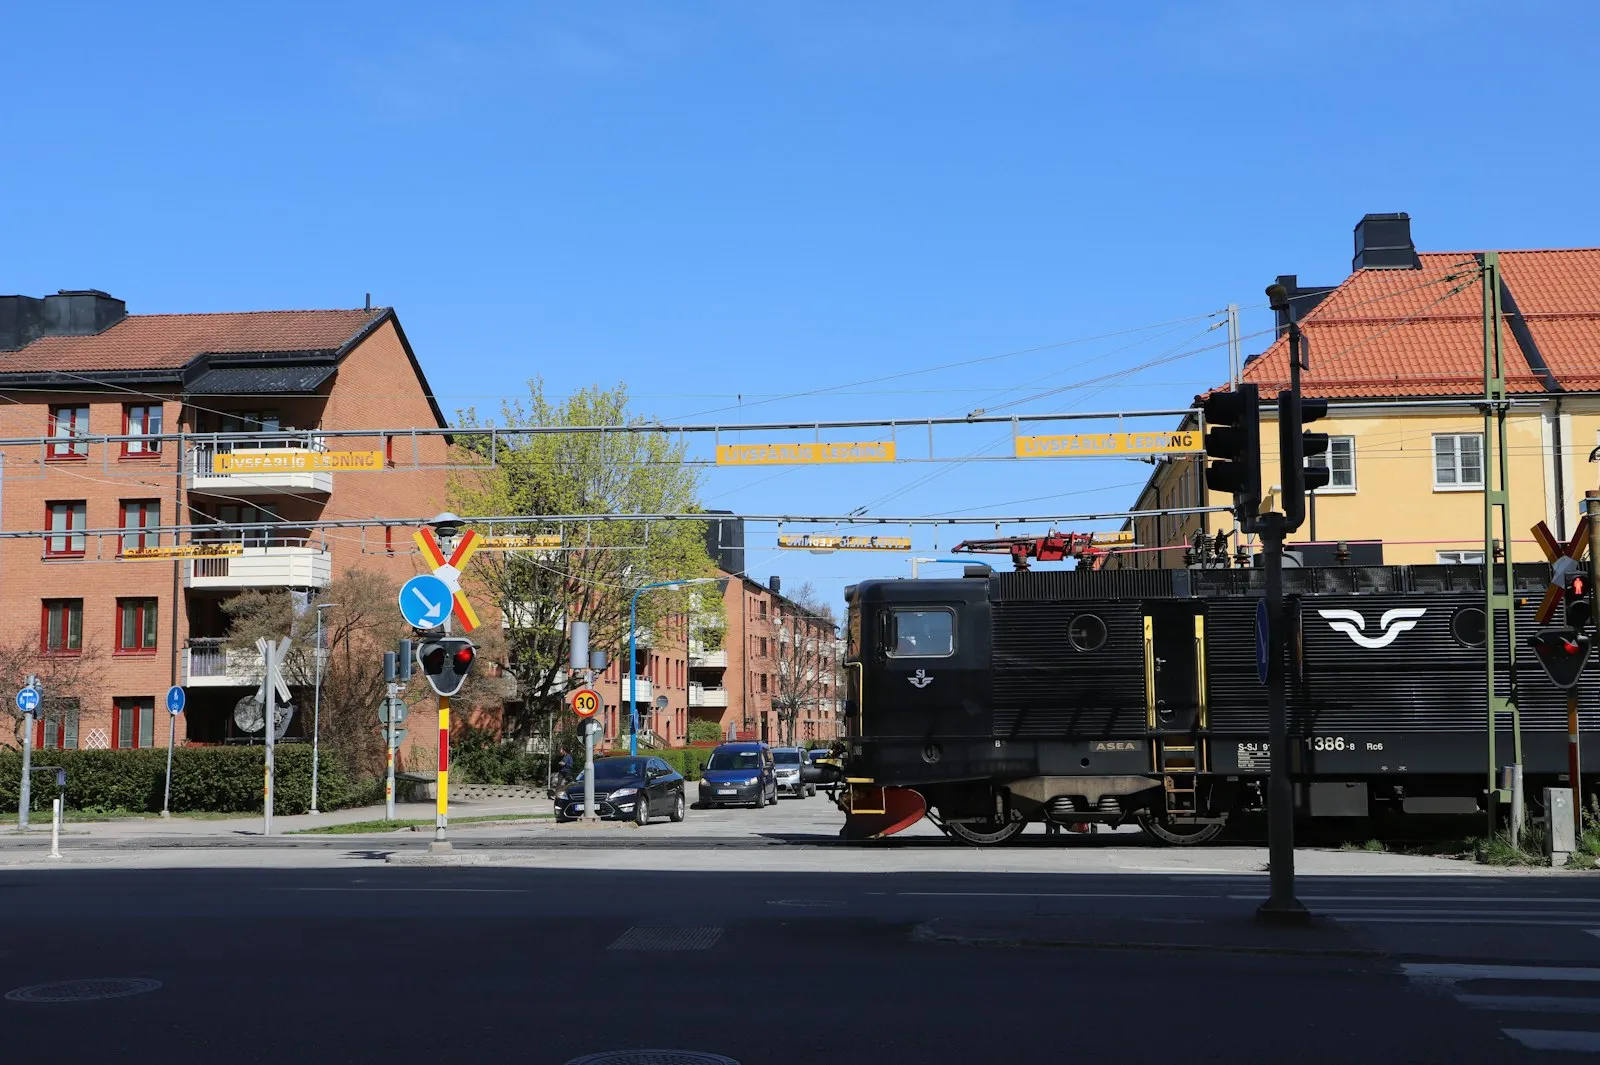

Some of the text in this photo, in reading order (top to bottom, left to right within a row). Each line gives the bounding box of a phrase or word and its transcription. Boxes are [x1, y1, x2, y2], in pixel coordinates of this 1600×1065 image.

[1025, 435, 1193, 453] LIVSFARLIG LEDNING
[724, 445, 887, 461] LIVSFARLIG LEDNING
[221, 456, 305, 469] LIVSFARLIG
[915, 669, 926, 679] SJ
[577, 696, 595, 710] 30
[1096, 742, 1135, 750] ASEA
[1238, 743, 1258, 751] S-SJ
[1366, 743, 1383, 751] Rc6
